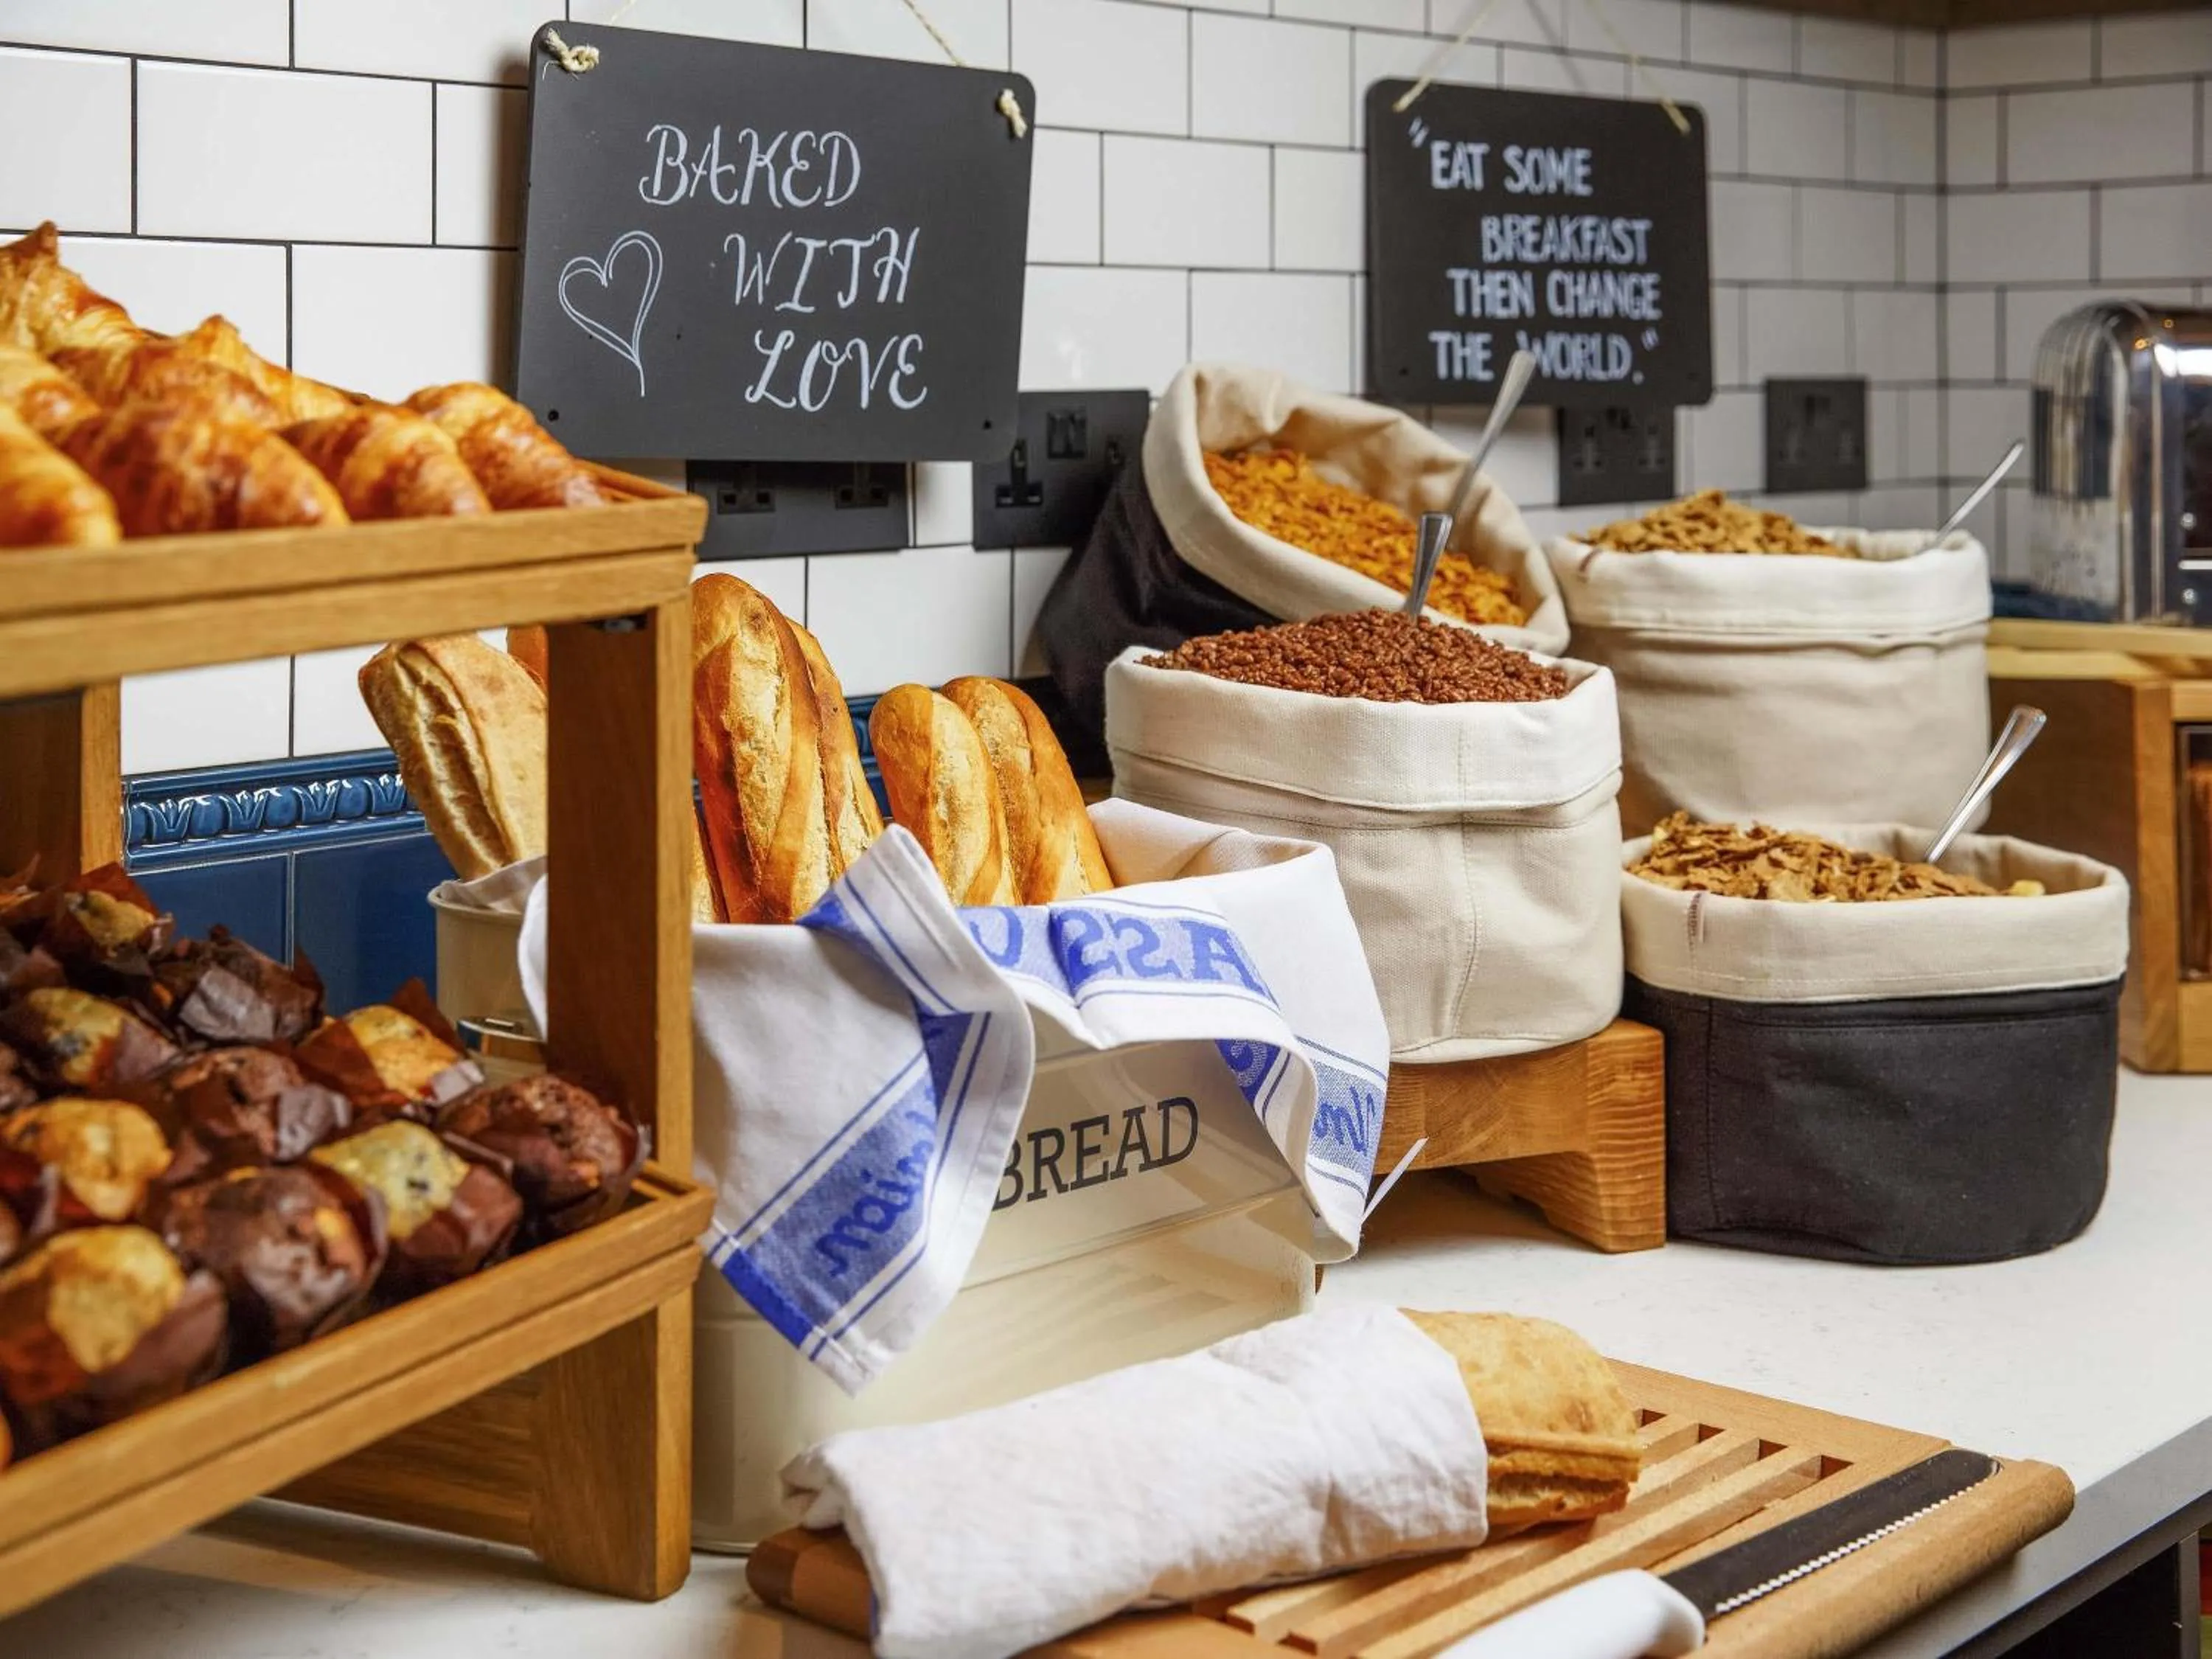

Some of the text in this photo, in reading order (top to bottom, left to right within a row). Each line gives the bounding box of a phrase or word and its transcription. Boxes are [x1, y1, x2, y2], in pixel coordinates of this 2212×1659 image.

[639, 124, 861, 208] BAKED
[1503, 145, 1593, 196] SOME
[723, 226, 920, 312] WITH
[1480, 214, 1652, 265] BREAKFAST
[1447, 268, 1663, 321] THEN CHANGE
[745, 329, 928, 412] LOVE
[1428, 330, 1495, 382] THE
[992, 1096, 1199, 1211] BREAD
